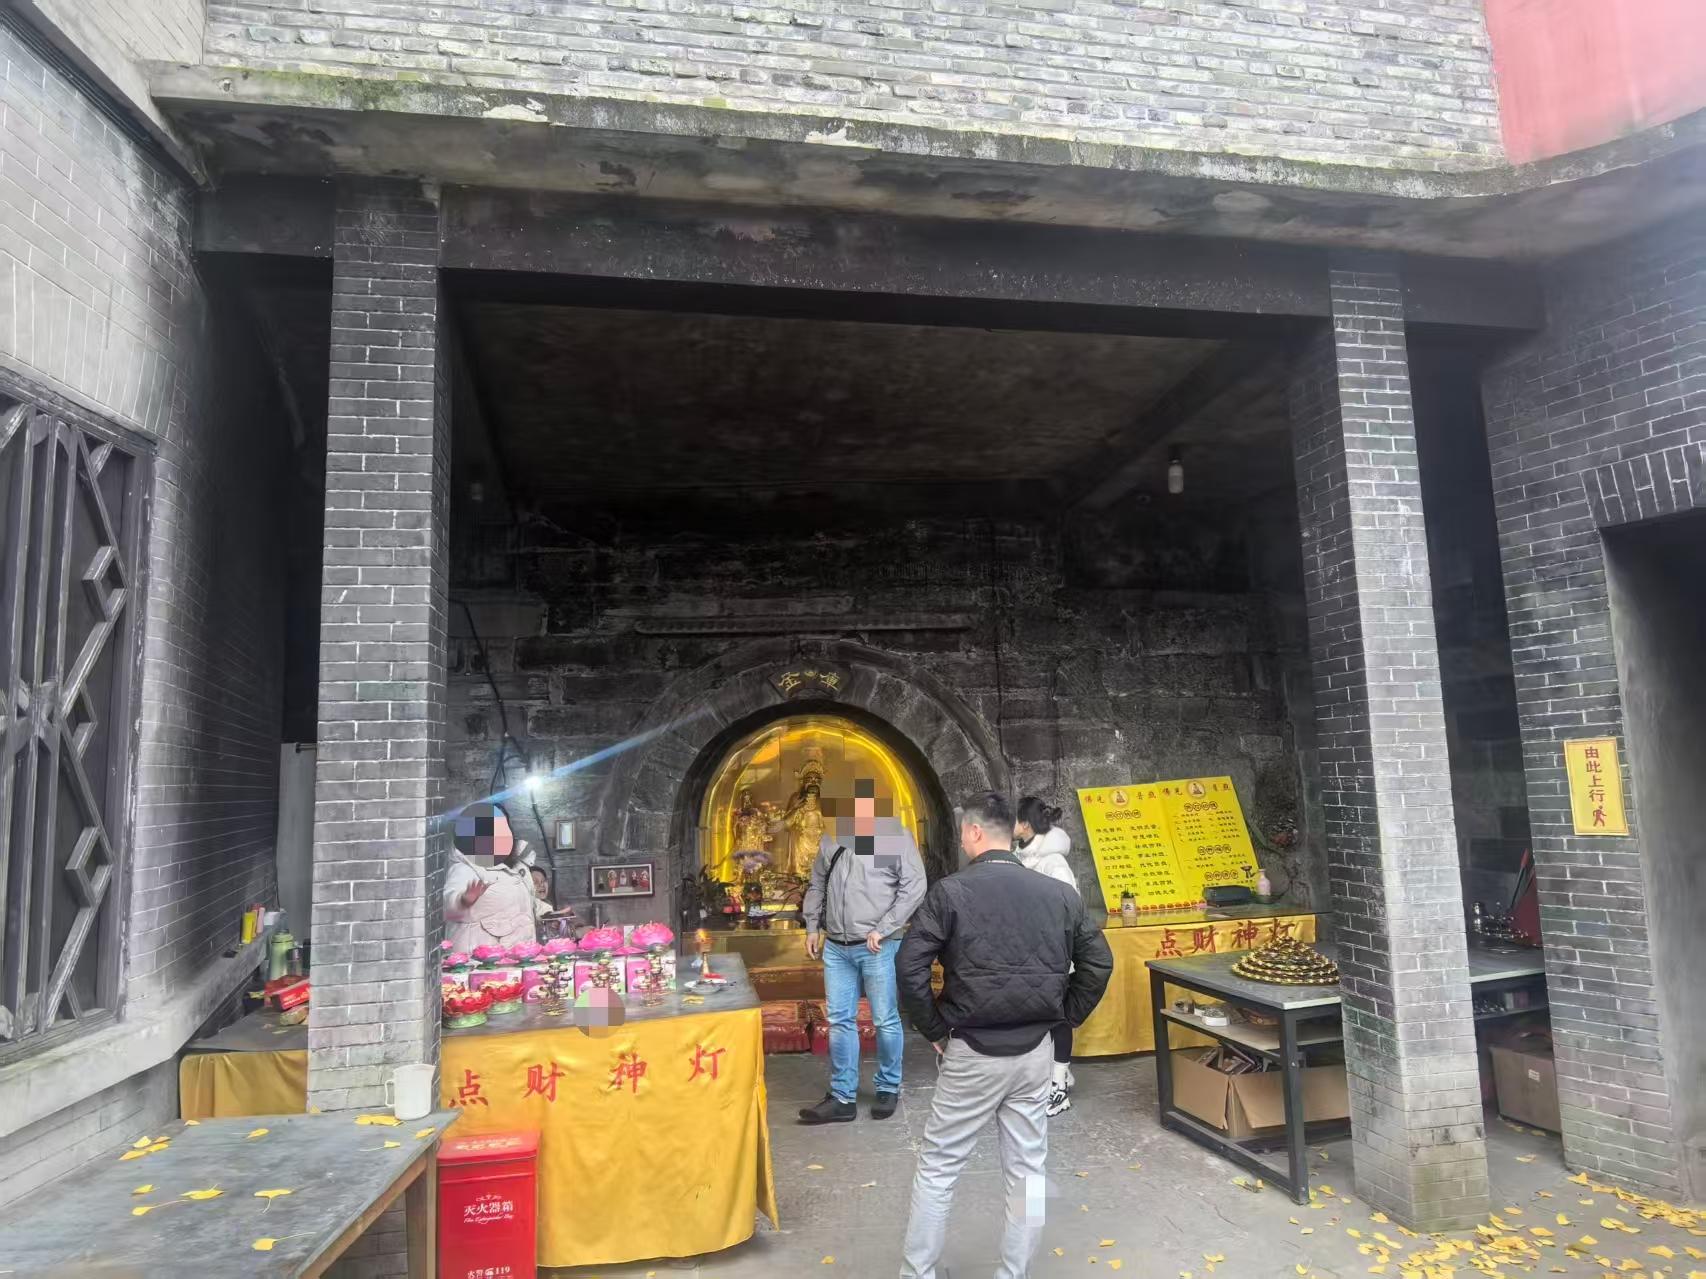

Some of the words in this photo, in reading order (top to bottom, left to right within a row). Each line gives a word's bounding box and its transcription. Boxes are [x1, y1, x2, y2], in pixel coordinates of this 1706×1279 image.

[1585, 746, 1605, 802] 由此上行
[1156, 917, 1295, 958] 点财神灯
[448, 1044, 726, 1107] 点财神灯
[463, 1200, 514, 1217] 灭火器箱
